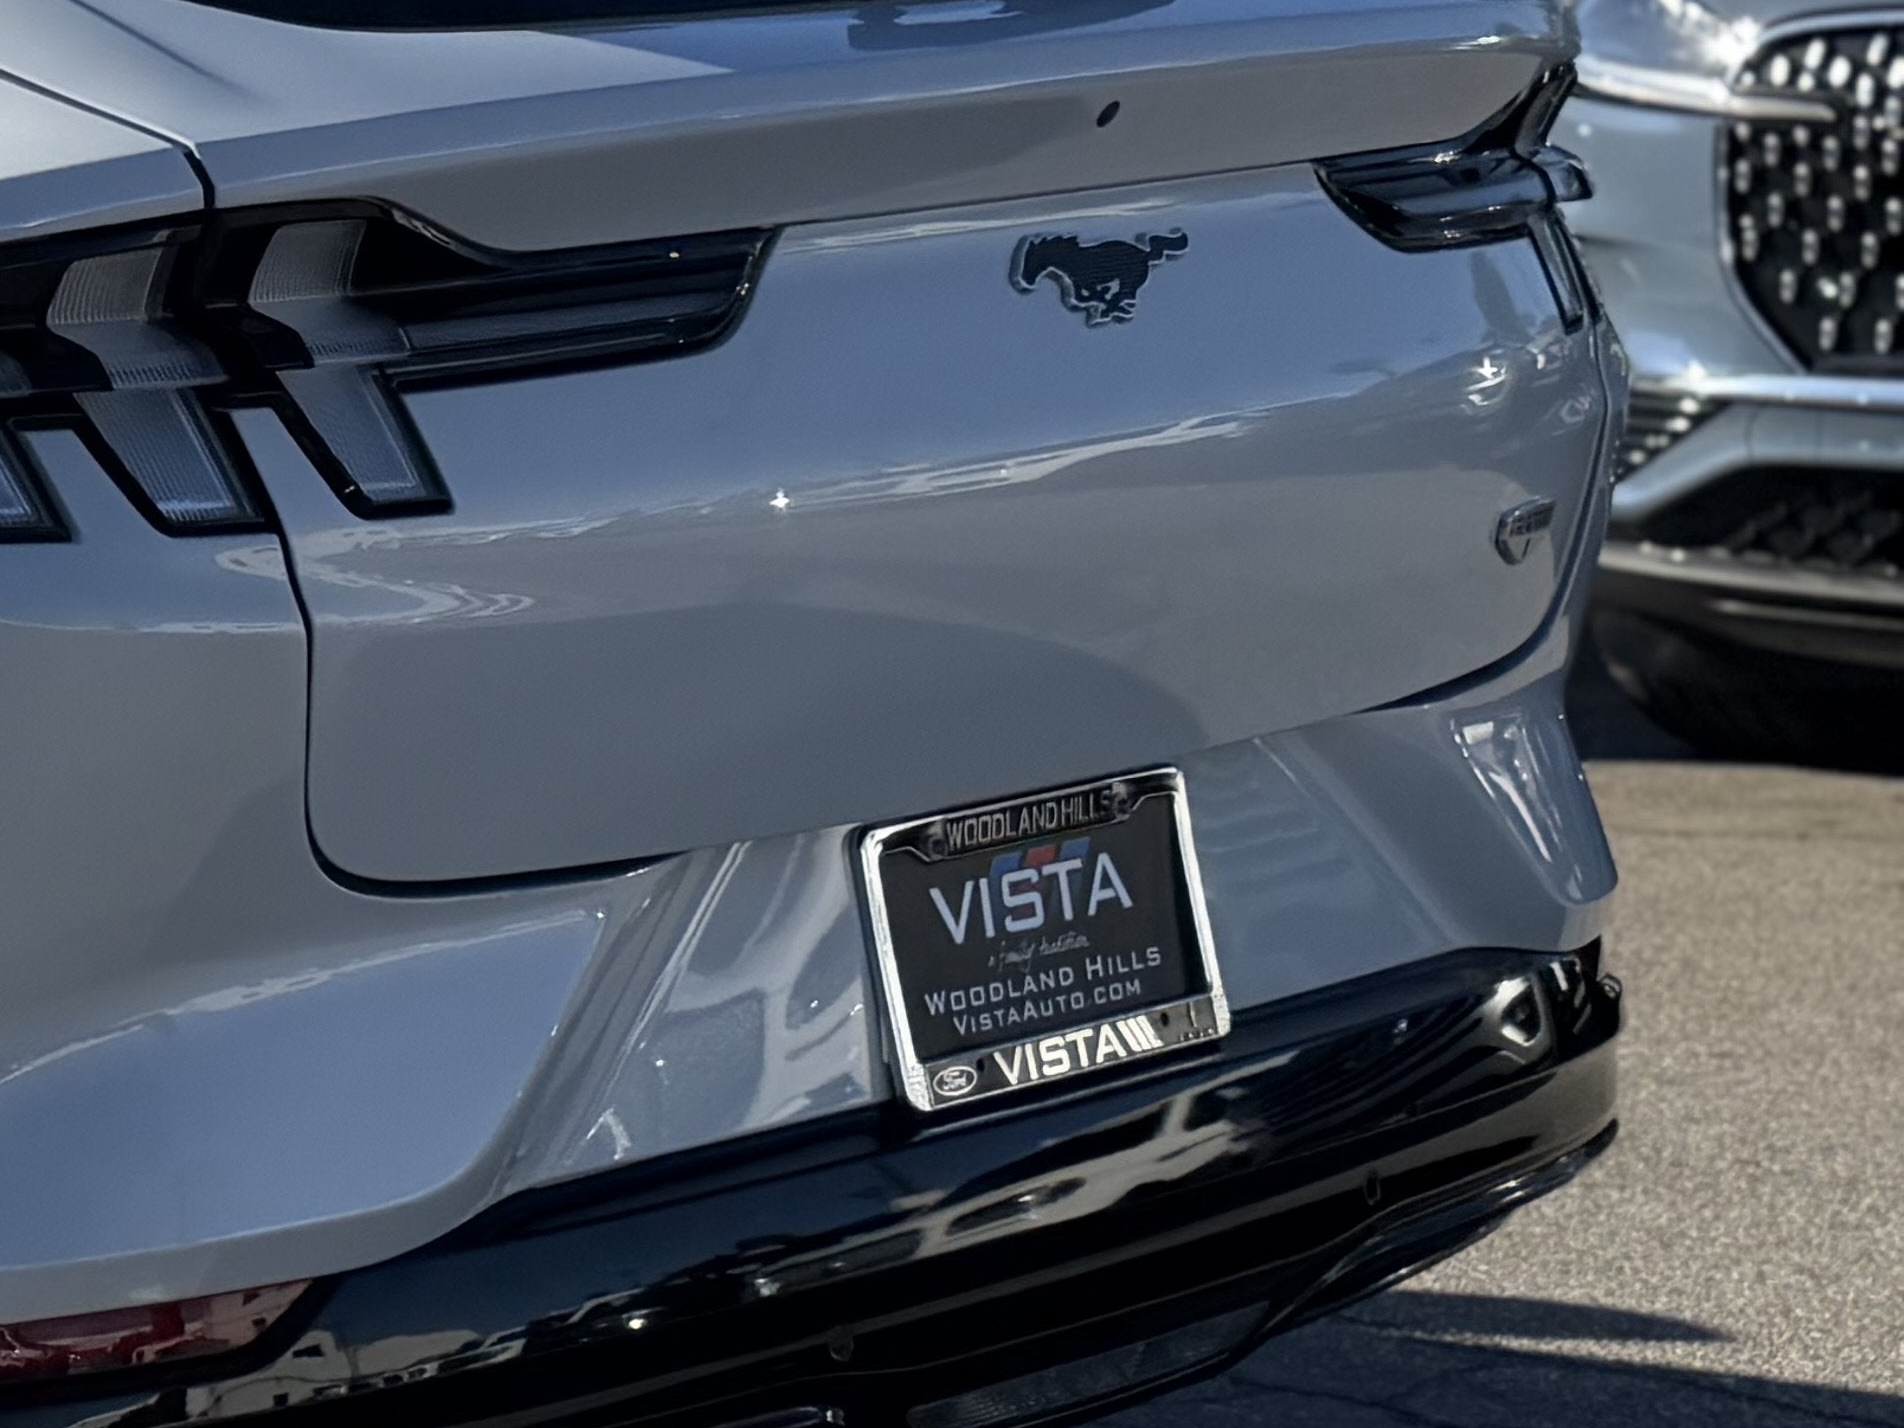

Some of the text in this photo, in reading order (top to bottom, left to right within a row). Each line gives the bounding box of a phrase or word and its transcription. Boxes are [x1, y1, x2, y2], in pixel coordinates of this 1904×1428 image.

[946, 789, 1112, 851] WOODLAND HILLS
[929, 852, 1134, 946] VISTA
[993, 1022, 1128, 1086] VISTA
